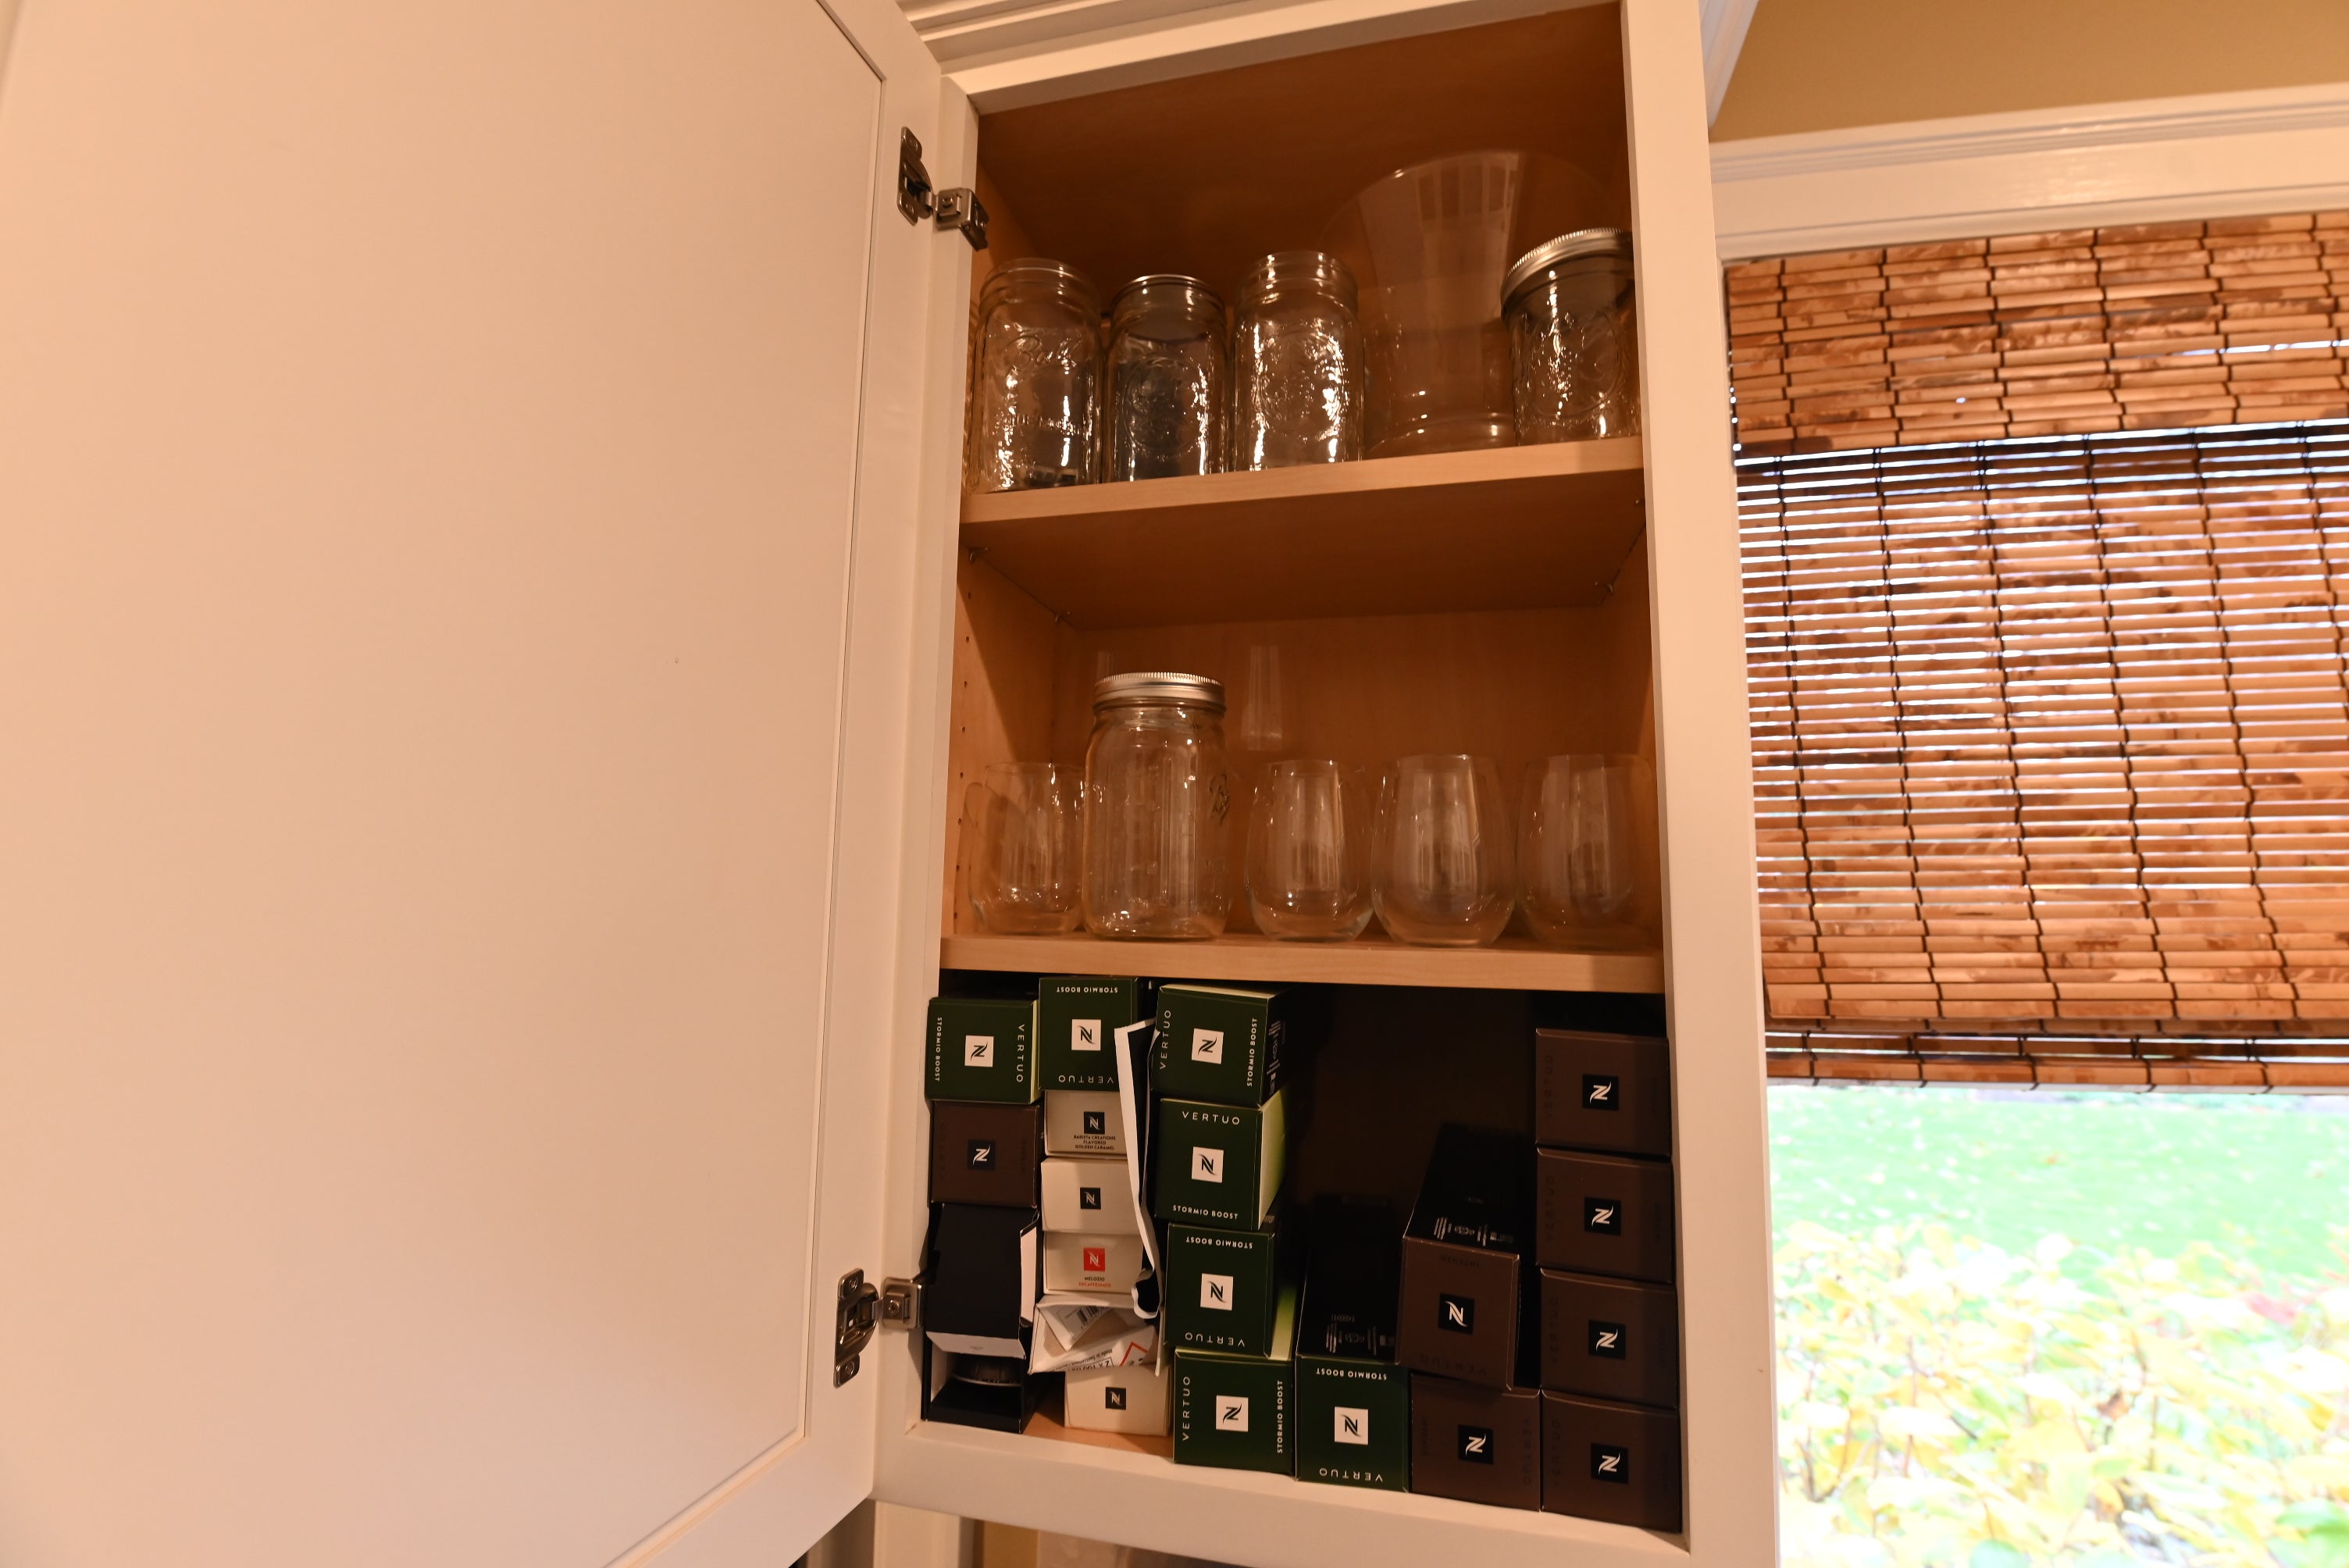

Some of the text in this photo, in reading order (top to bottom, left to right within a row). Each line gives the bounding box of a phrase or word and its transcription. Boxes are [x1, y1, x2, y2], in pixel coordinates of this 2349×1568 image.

[1160, 1010, 1171, 1070] VERTUO
[1016, 1024, 1025, 1083] VERTUO
[1058, 1074, 1114, 1084] VERTUO
[1182, 1110, 1240, 1125] VERTUO
[1173, 1204, 1239, 1220] STORMIO BOOST
[1185, 1236, 1253, 1249] STORMIO BOOST
[1185, 1332, 1246, 1347] VERTUO
[1316, 1367, 1387, 1381] STORMIO BOOST
[1182, 1376, 1191, 1441] VERTUO
[1319, 1467, 1383, 1483] VERTUO
